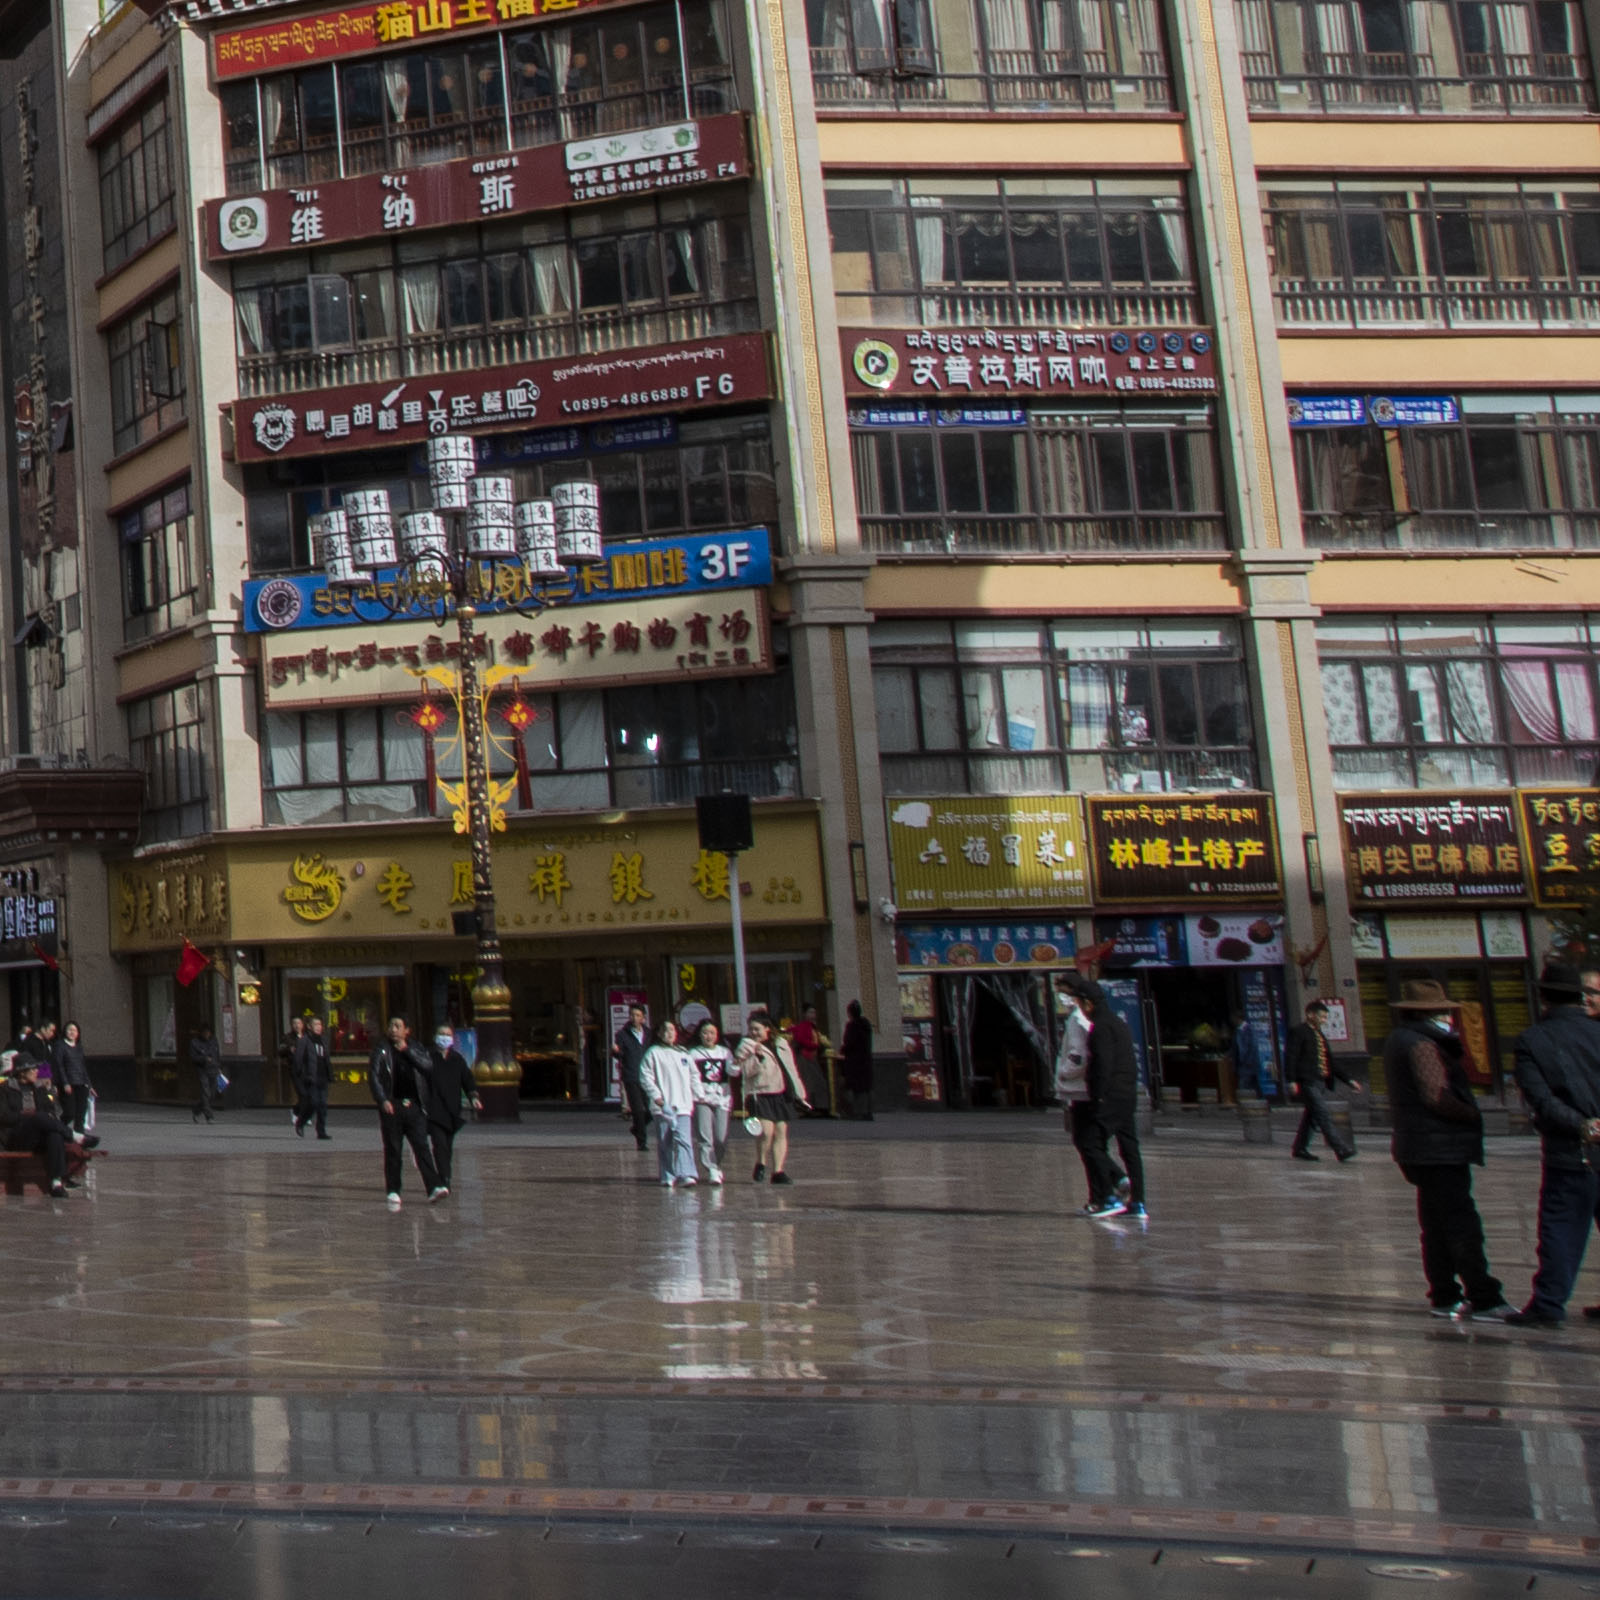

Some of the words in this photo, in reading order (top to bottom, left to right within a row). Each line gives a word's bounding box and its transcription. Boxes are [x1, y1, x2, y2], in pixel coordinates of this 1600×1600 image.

[718, 162, 737, 177] F4
[290, 175, 516, 243] 维纳斯
[910, 354, 1109, 391] 艾普拉斯网咖
[572, 386, 689, 411] 0895-4866888
[700, 541, 751, 581] 3F
[919, 829, 1066, 868] 六福冒菜
[1108, 837, 1265, 870] 林峰土特产
